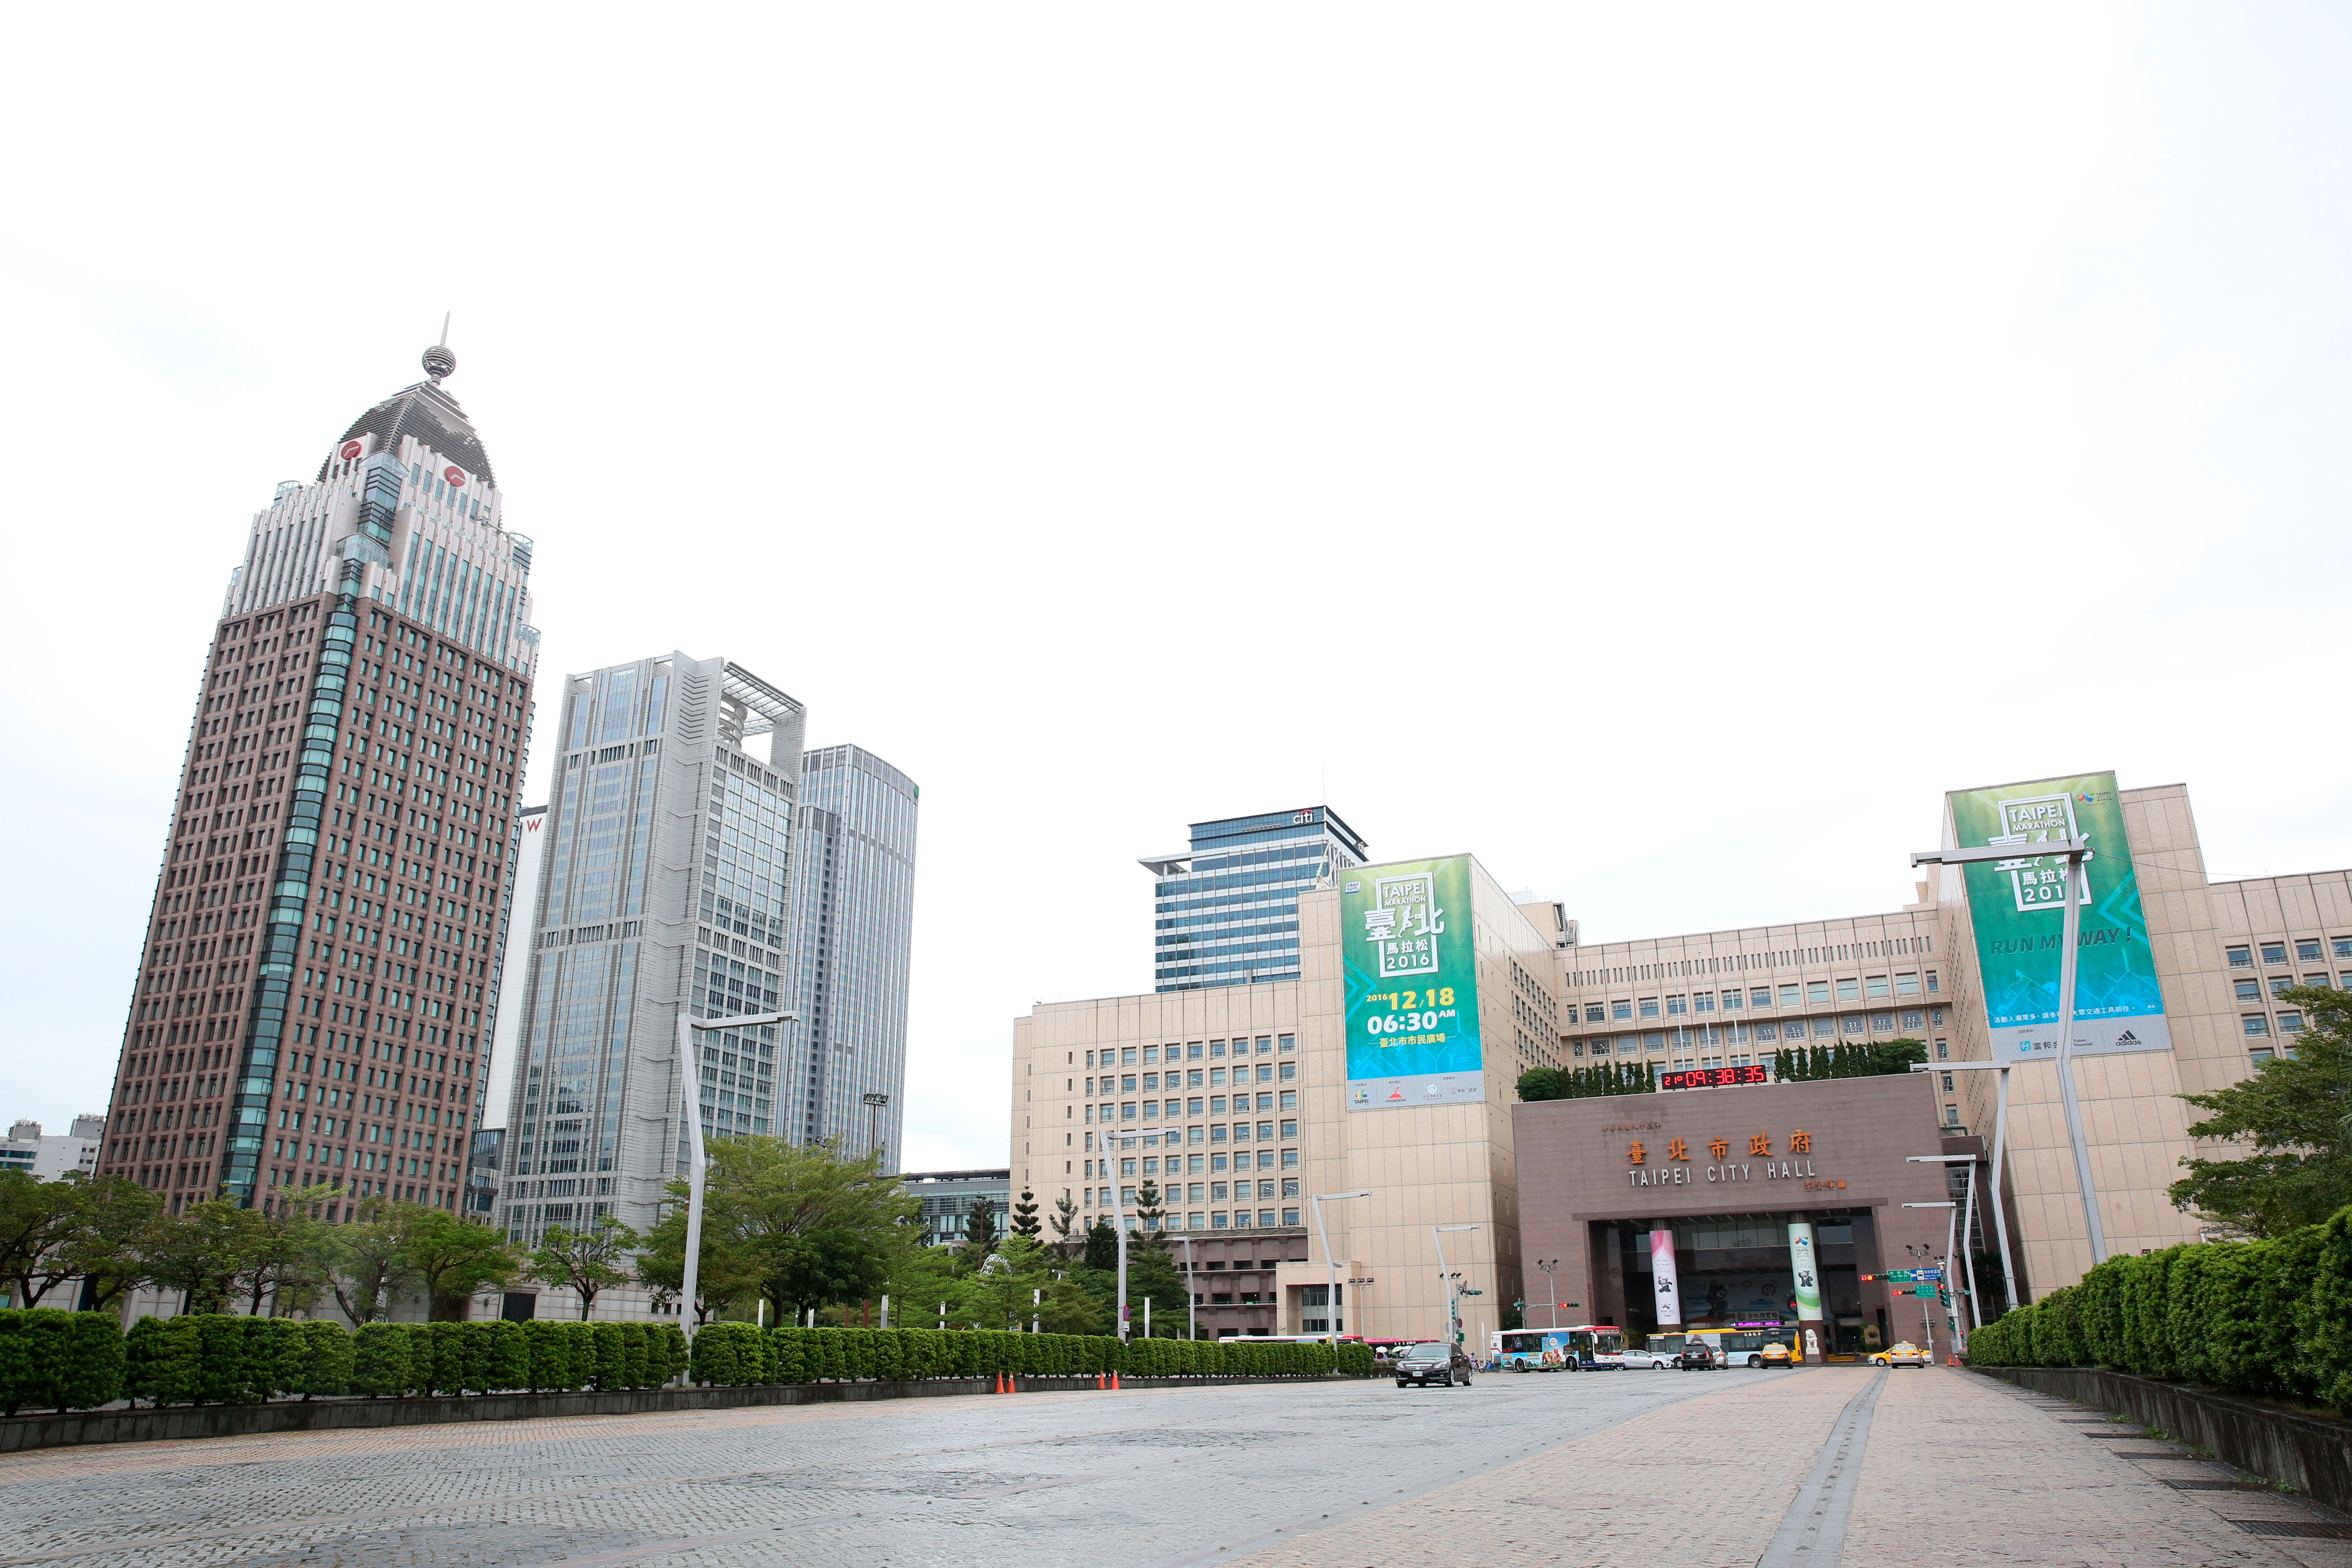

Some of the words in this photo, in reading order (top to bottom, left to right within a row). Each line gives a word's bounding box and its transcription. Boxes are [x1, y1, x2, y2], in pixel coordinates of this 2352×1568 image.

[1293, 809, 1314, 824] citi
[2009, 802, 2063, 822] TAIPEI
[527, 817, 542, 833] W
[2013, 819, 2065, 832] MARATHON
[1383, 880, 1425, 898] TAIPEI
[2024, 885, 2063, 902] 201
[1385, 896, 1426, 906] MARATHON
[1387, 939, 1428, 955] 馬拉松
[1991, 936, 2034, 956] RUN
[2078, 928, 2120, 947] WAY
[1387, 953, 1430, 969] 2016
[1366, 993, 1388, 1002] 2016
[1389, 987, 1454, 1011] 12/18
[1368, 1011, 1438, 1034] 06:30
[1438, 1009, 1455, 1018] AM
[1379, 1033, 1446, 1048] 臺北市市民廣場
[2033, 1040, 2058, 1050] 富邦
[1686, 1066, 1764, 1087] 09:38:35
[1627, 1129, 1811, 1164] 臺北市政府
[1629, 1167, 1690, 1186] TAIPEI
[1707, 1164, 1749, 1182] CITY
[1767, 1160, 1815, 1179] HALL
